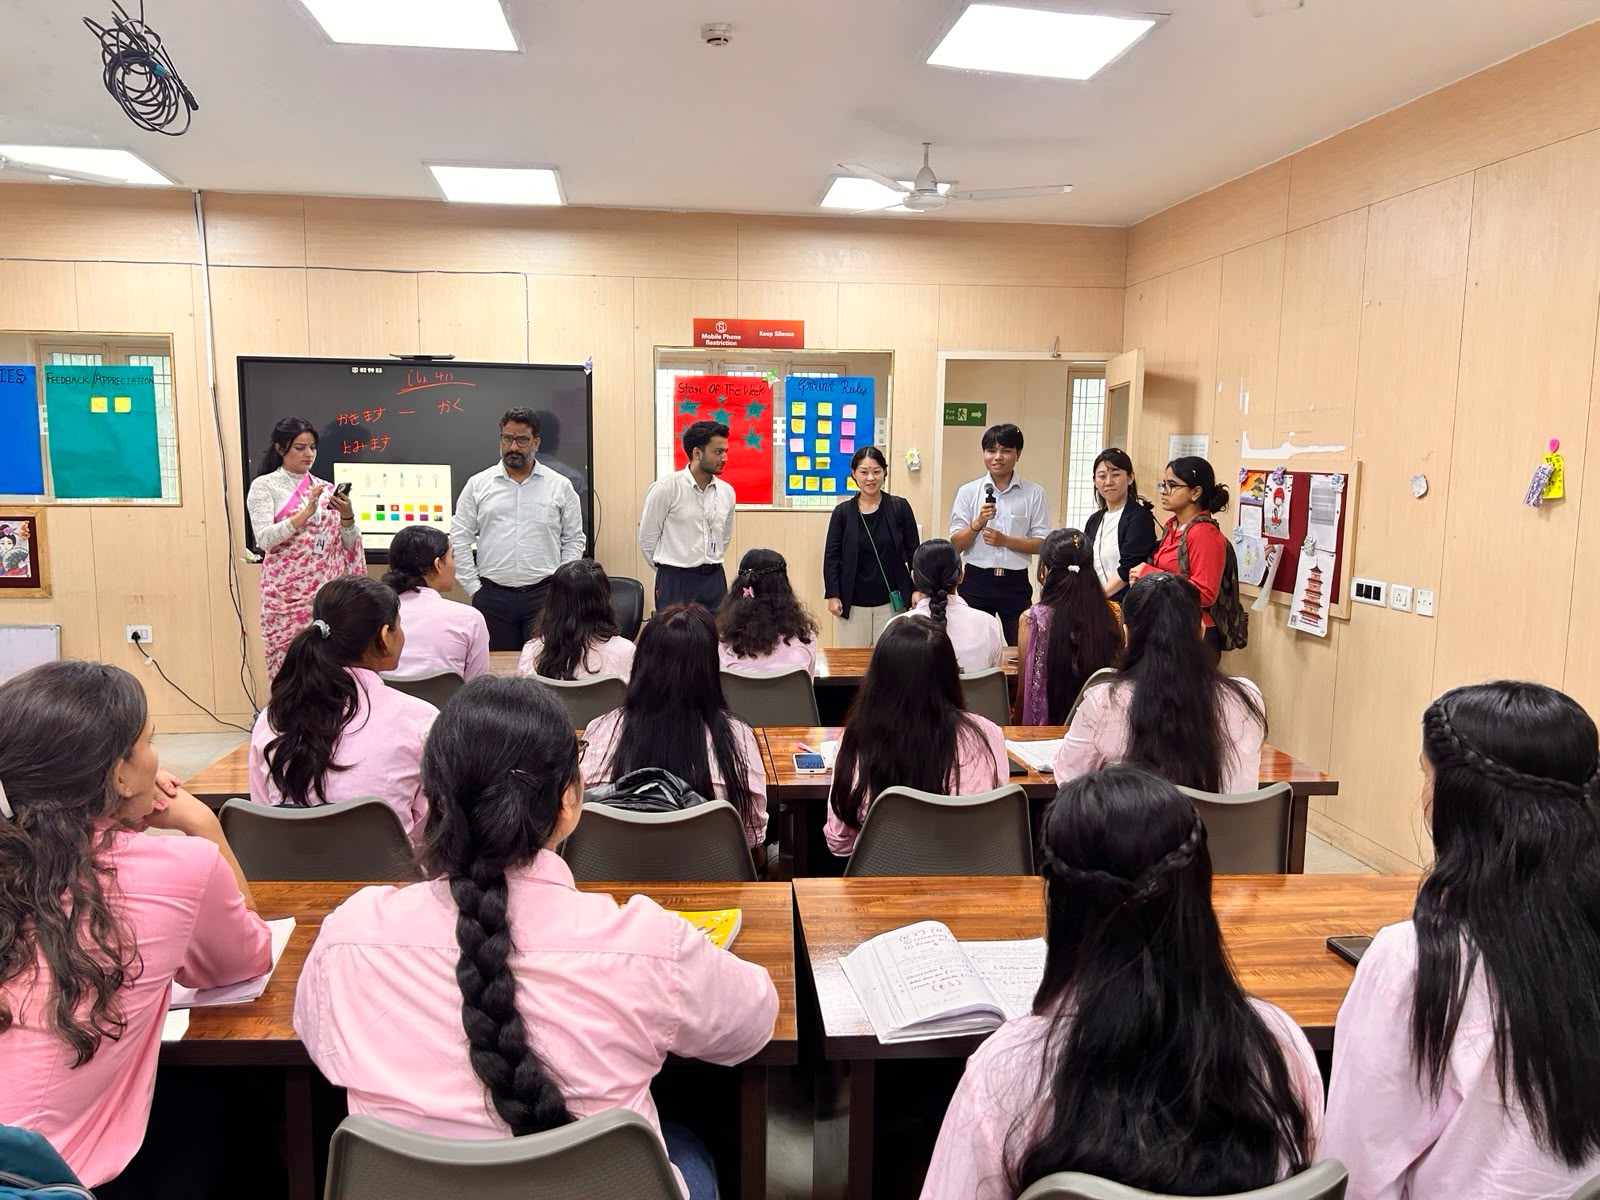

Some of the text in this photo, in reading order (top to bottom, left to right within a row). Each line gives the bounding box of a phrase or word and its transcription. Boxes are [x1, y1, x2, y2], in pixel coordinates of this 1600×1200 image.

[708, 382, 719, 394] Of
[724, 383, 742, 396] The
[743, 384, 766, 396] Week
[797, 378, 868, 396] Ground Rules
[437, 398, 465, 415] かく
